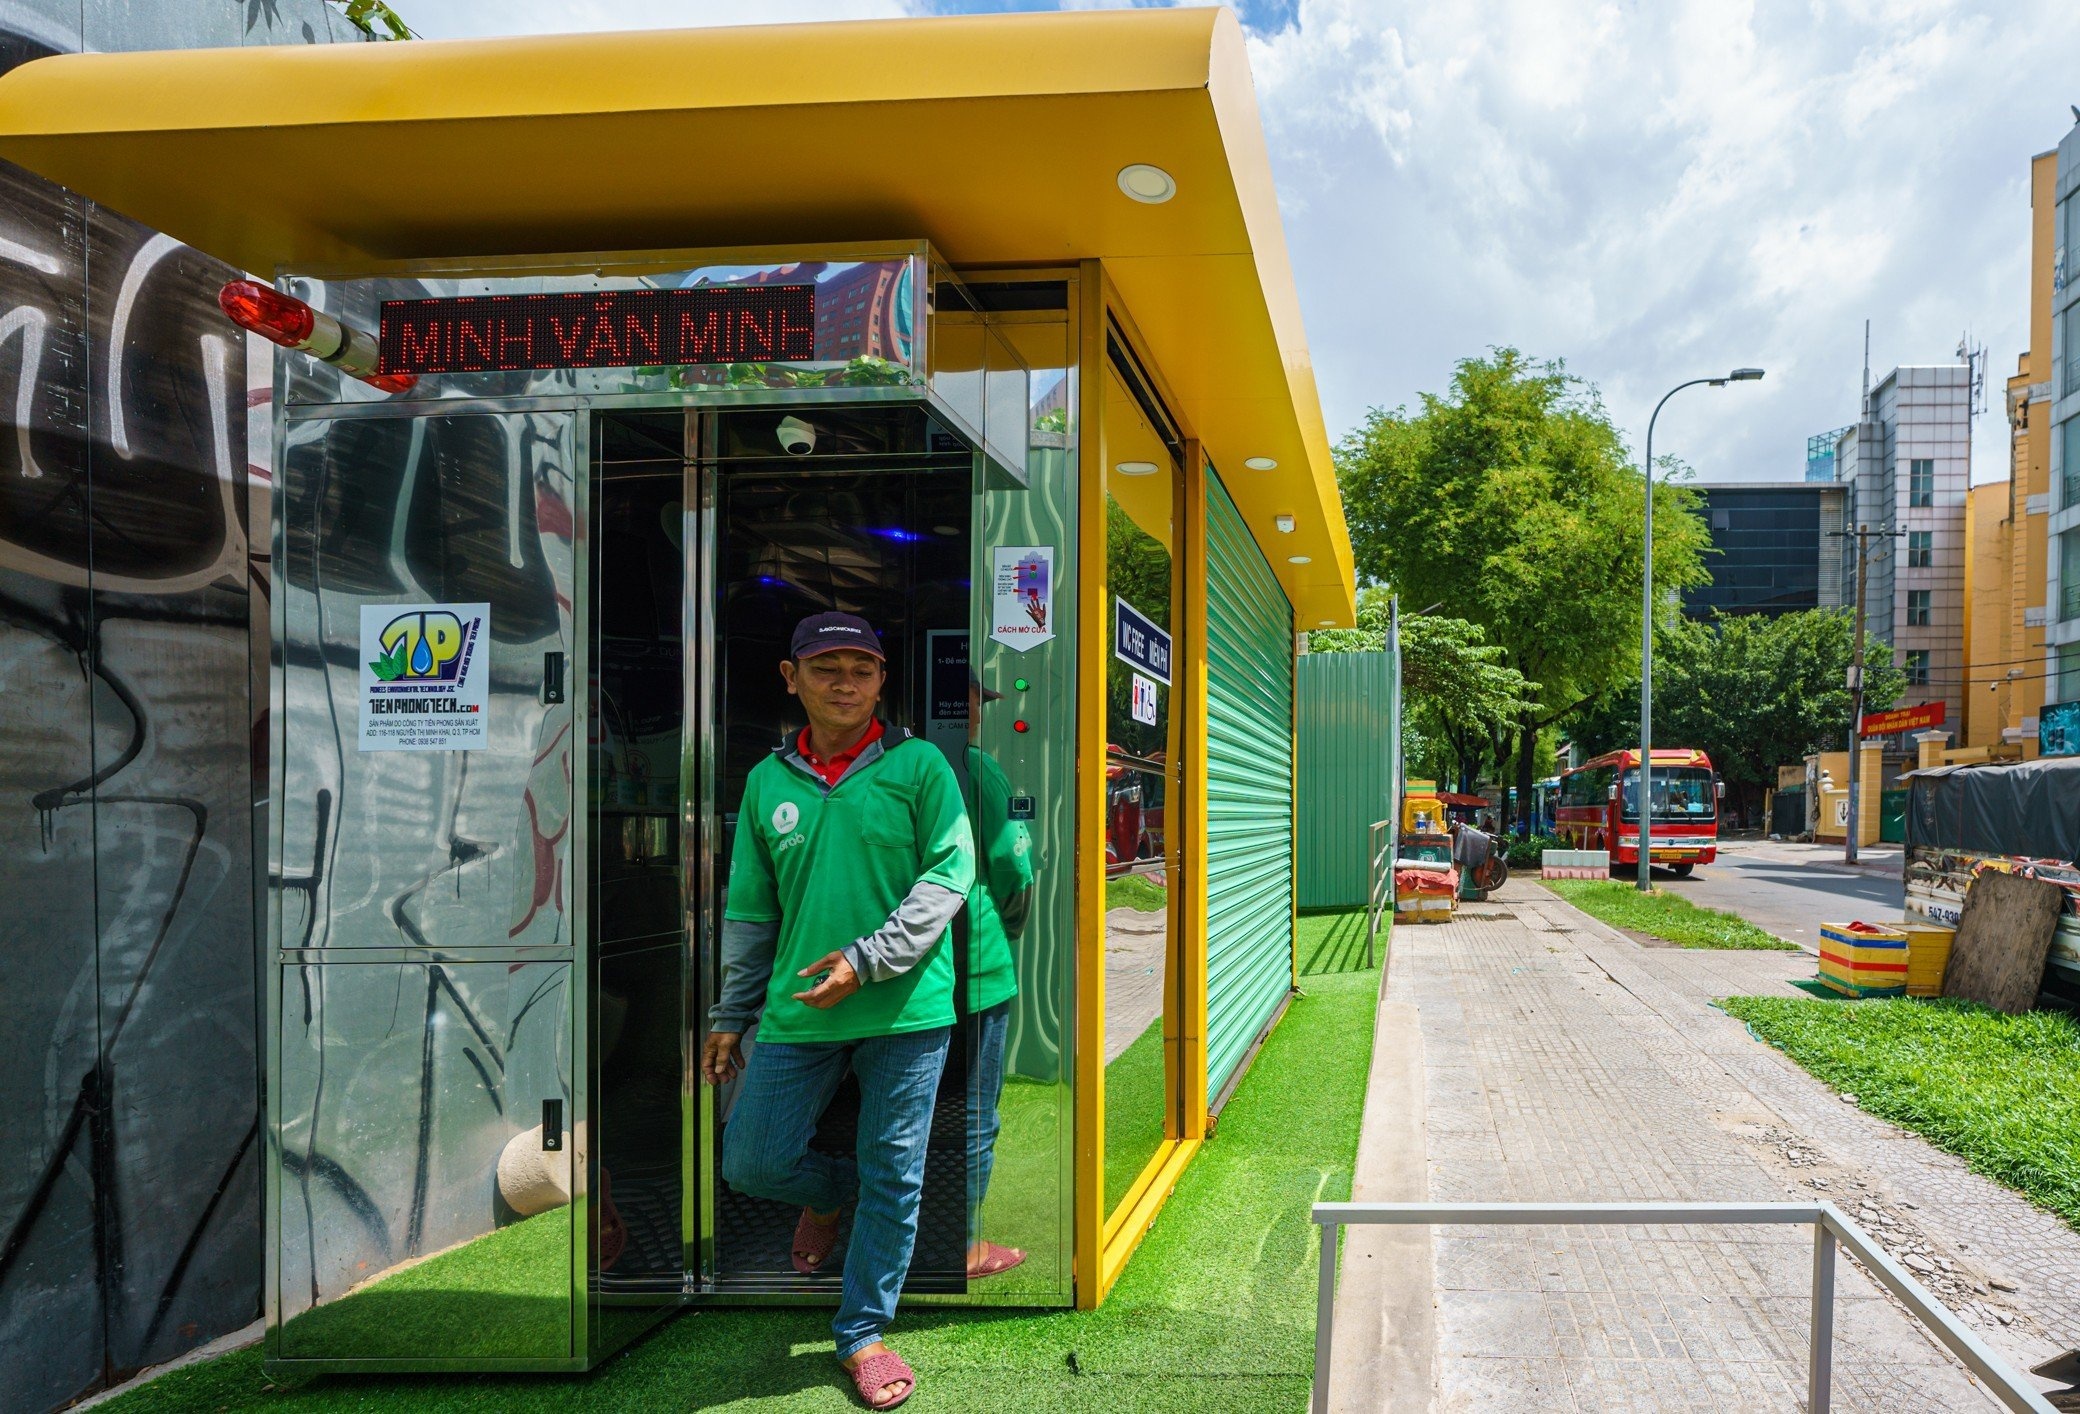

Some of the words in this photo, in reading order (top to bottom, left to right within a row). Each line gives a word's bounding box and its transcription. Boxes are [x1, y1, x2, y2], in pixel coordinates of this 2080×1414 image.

[402, 318, 531, 364] MINH
[680, 308, 815, 354] MINH
[997, 625, 1017, 634] CÁCH
[1131, 627, 1145, 660] FREE
